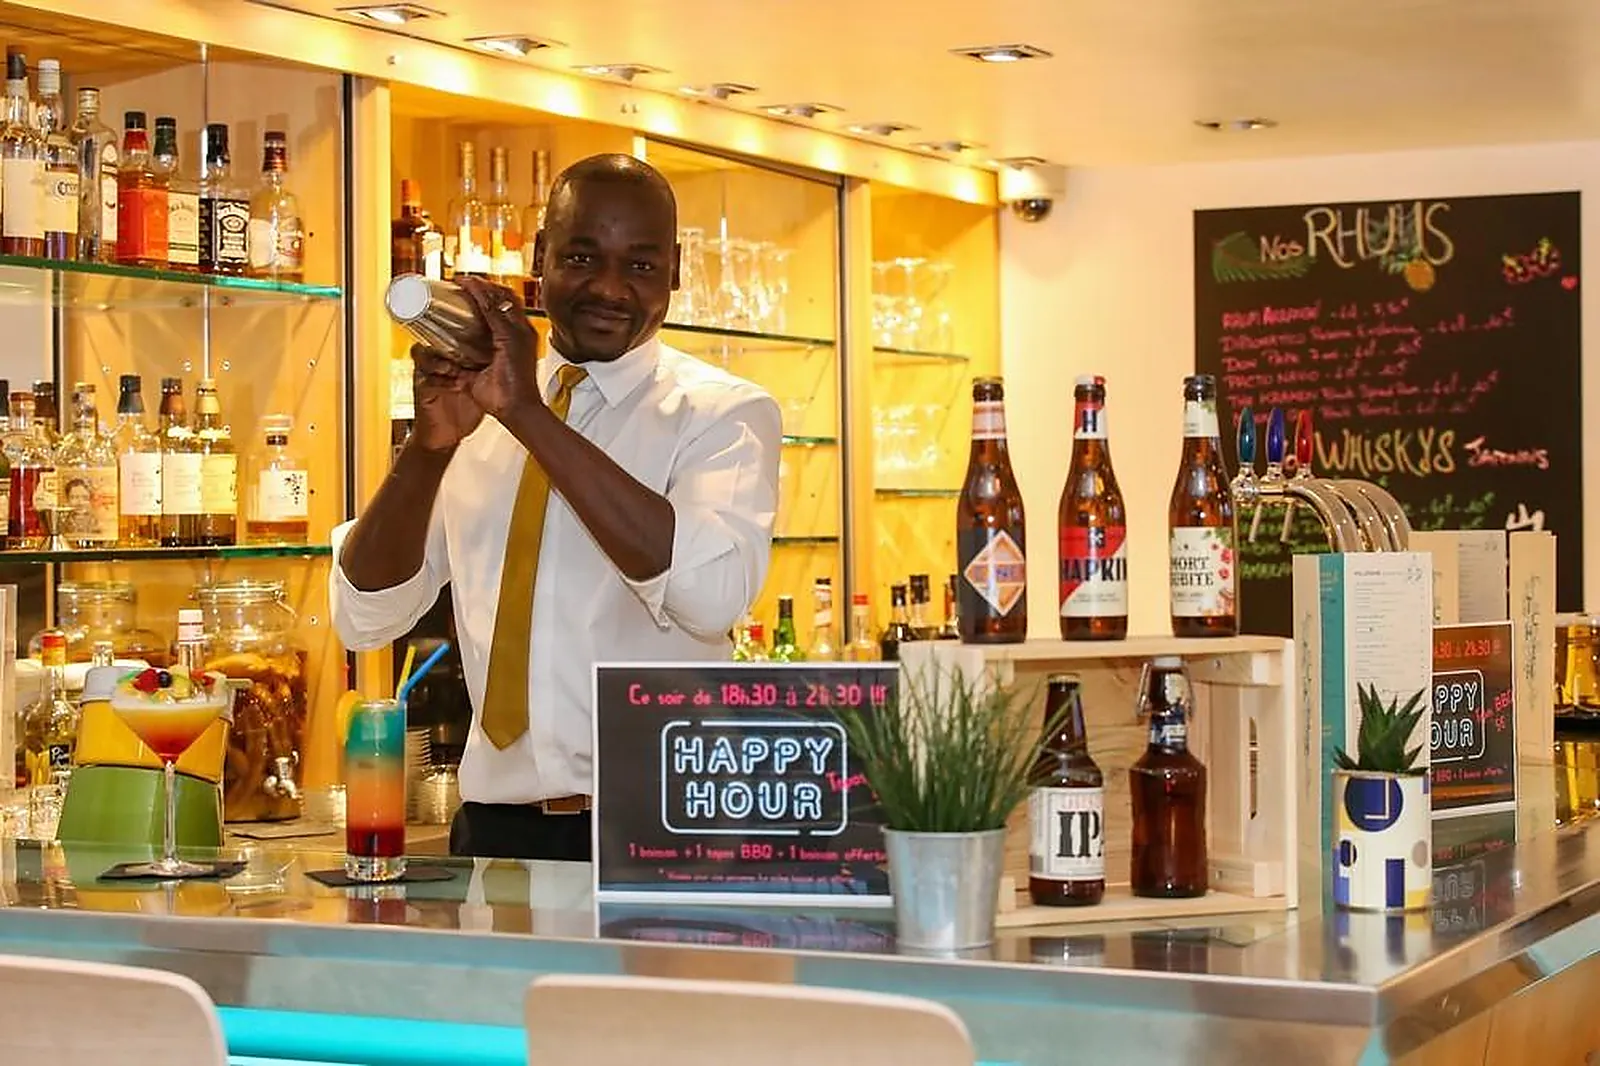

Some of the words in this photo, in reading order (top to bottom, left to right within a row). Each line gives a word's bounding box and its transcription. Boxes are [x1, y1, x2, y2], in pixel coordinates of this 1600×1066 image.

[629, 683, 650, 705] Ce
[1430, 717, 1474, 752] OUR
[674, 737, 833, 774] HAPPY
[685, 781, 823, 820] HOUR
[741, 844, 773, 859] BBQ
